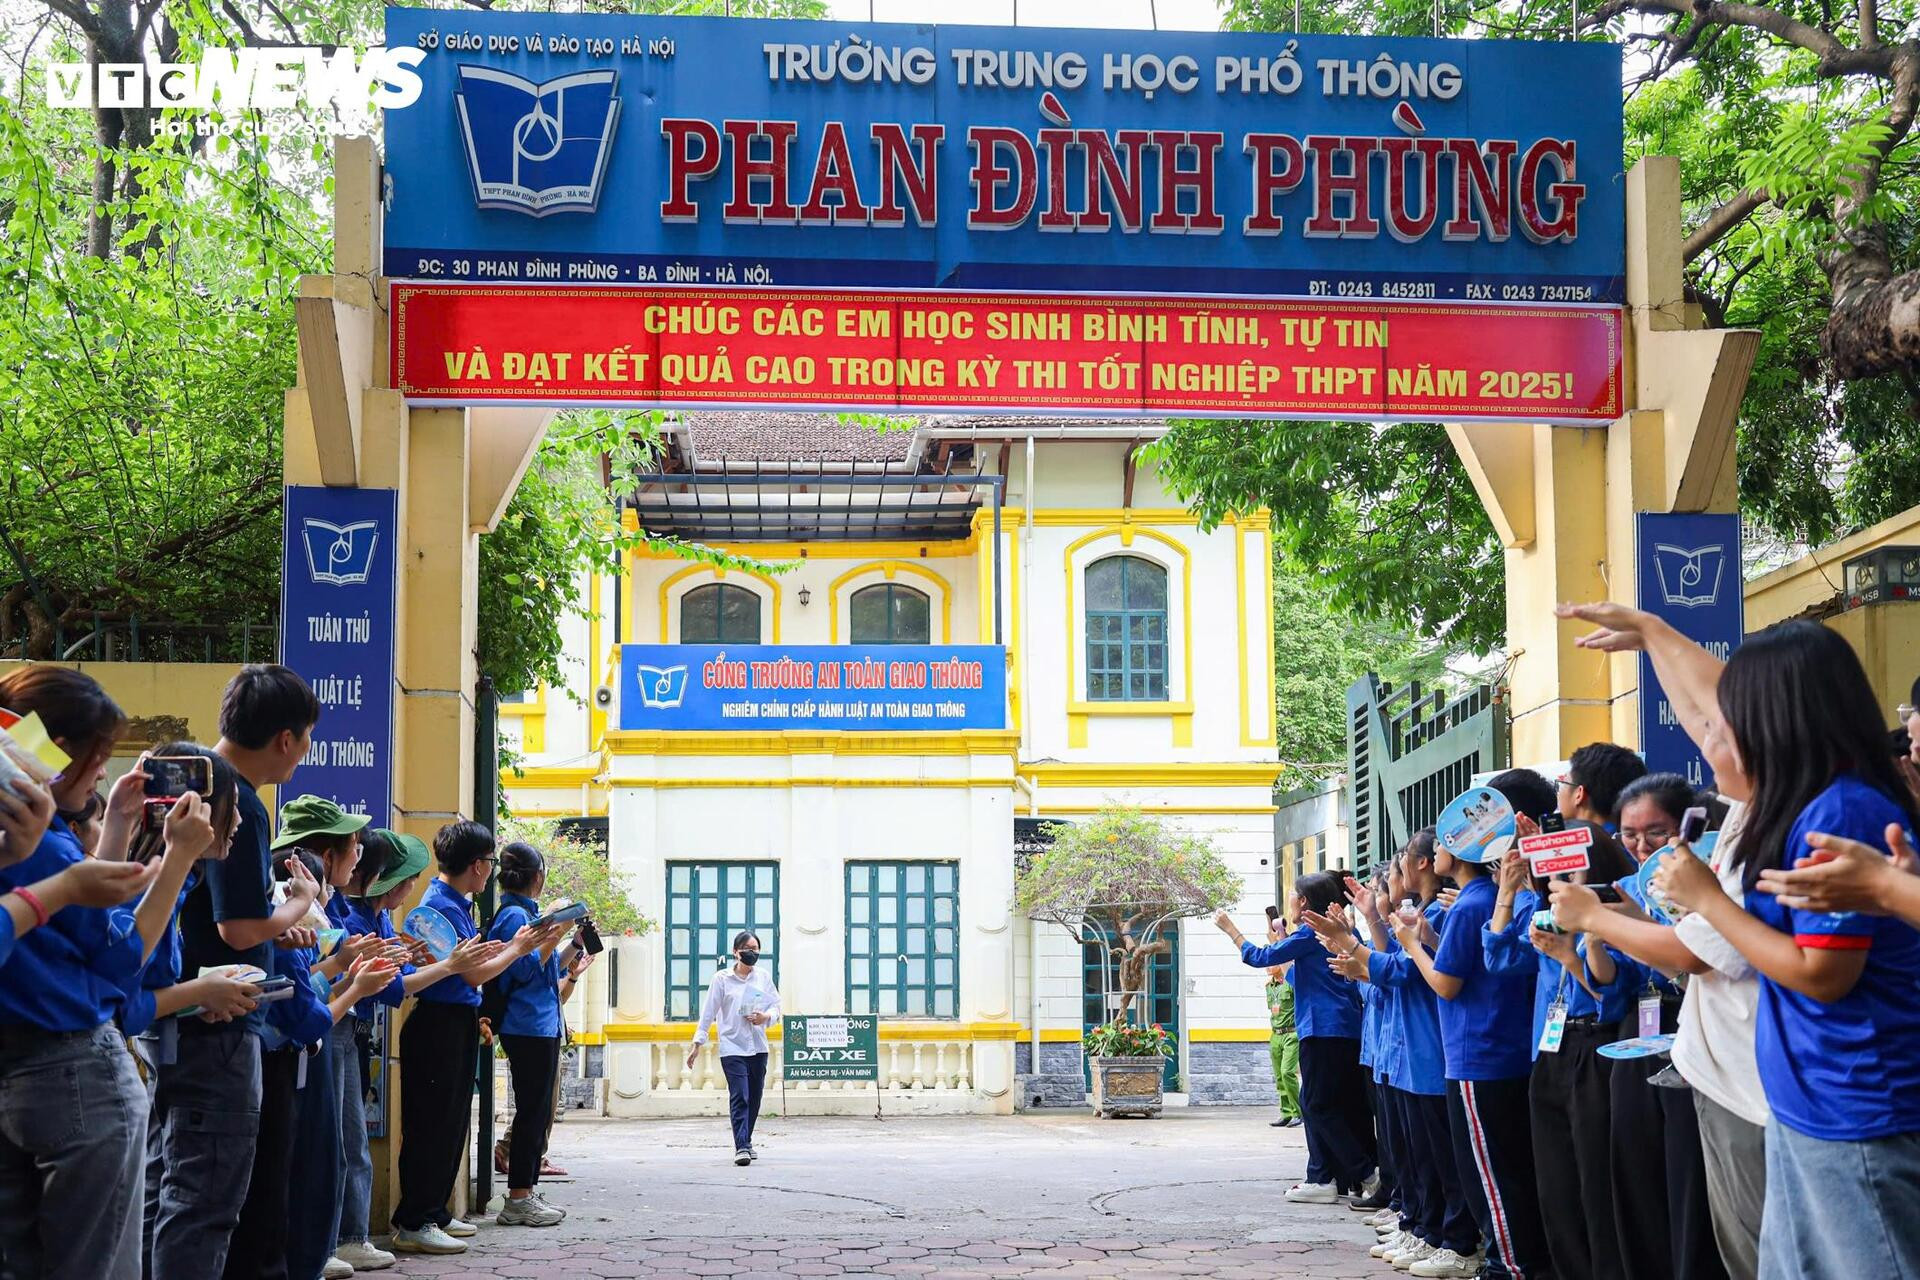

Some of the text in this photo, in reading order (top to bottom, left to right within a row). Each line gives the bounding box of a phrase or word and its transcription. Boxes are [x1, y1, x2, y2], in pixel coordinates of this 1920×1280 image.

[418, 29, 675, 59] SỞ GIÁO DỤC VÀ ĐÀO TẠO HÀ NỘI
[763, 33, 1463, 100] TRƯỜNG TRUNG HỌC PHỔ THÔNG
[660, 91, 1586, 245] PHAN ĐÌNH PHÙNG
[418, 259, 445, 275] ĐC:
[453, 259, 470, 275] 30
[477, 260, 518, 277] PHAN
[525, 257, 561, 278] ĐÌNH
[568, 260, 618, 280] PHÙNG
[638, 265, 657, 282] BA
[665, 261, 700, 283] ĐÌNH
[716, 263, 736, 284] HÀ
[1309, 281, 1332, 297] ĐT:
[1338, 281, 1372, 297] 0243
[1382, 282, 1435, 299] 8452811
[1502, 284, 1535, 300] 0243
[644, 301, 1389, 353] CHÚC CÁC EM HỌC SINH BÌNH TĨNH, TỰ TIN
[444, 344, 1574, 400] VÀ ĐẠT KẾT QUẢ CAO TRONG KỲ THI TỐT NGHIỆP THPT NĂM 2025!
[1862, 589, 1879, 603] MSB
[308, 610, 370, 643] TUÂN THỦ
[703, 651, 983, 688] CỔNG TRƯỜNG AN TOÀN GIAO THÔNG
[312, 674, 362, 710] LUẬT LỆ
[722, 700, 759, 718] NGHIÊM
[792, 698, 816, 718] CHẤP
[819, 700, 844, 718] HÀNH
[846, 700, 868, 720] LUẬT
[870, 703, 883, 717] AN
[885, 700, 910, 717] TOÀN
[912, 703, 933, 717] GIAO
[935, 700, 966, 717] THÔNG
[1659, 701, 1681, 731] HẠ
[298, 737, 374, 767] IAO THÔNG
[1687, 756, 1703, 785] LÀ
[791, 1020, 804, 1030] RA
[839, 1050, 867, 1061] XE
[855, 1068, 872, 1077] MINH
